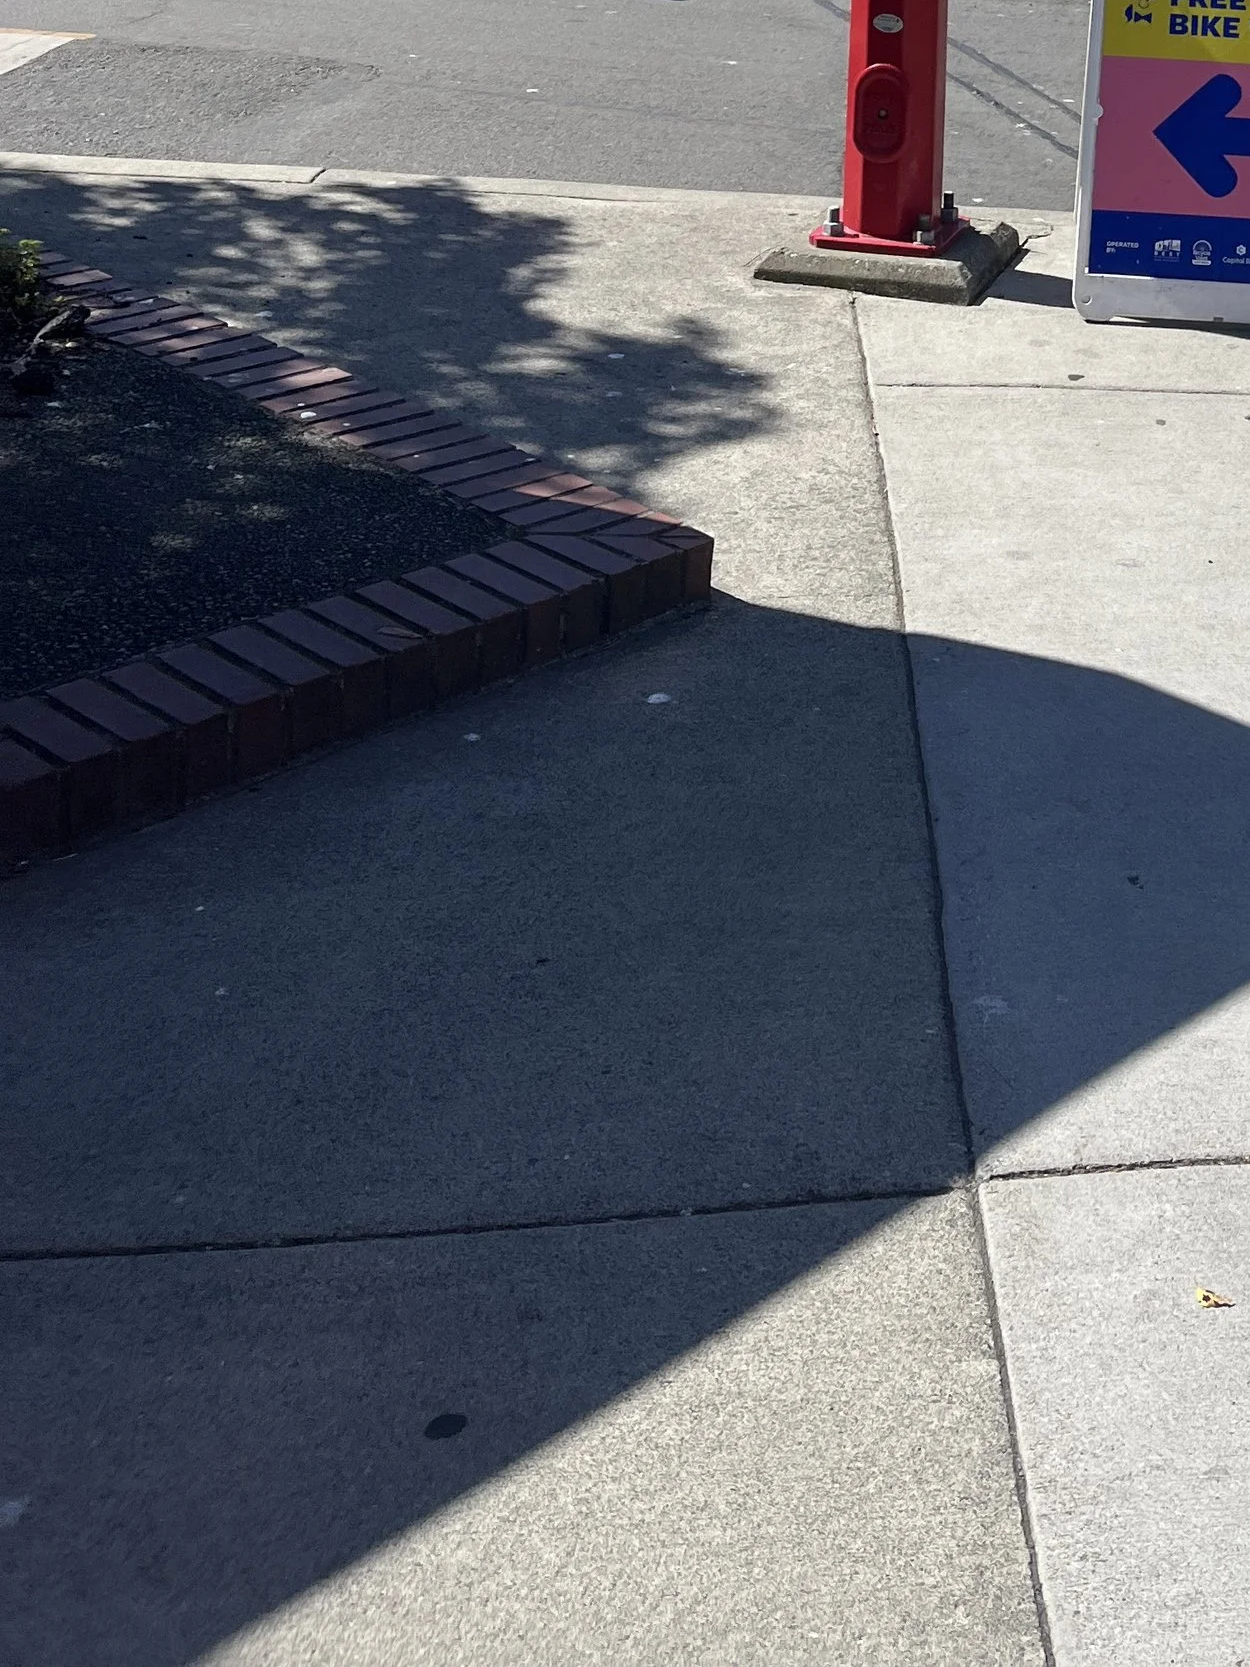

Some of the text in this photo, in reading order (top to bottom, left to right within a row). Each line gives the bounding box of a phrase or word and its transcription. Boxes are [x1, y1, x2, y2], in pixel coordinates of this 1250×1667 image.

[1169, 13, 1241, 39] BIKE
[1106, 240, 1139, 249] OPERATED
[1222, 256, 1245, 265] Capital
